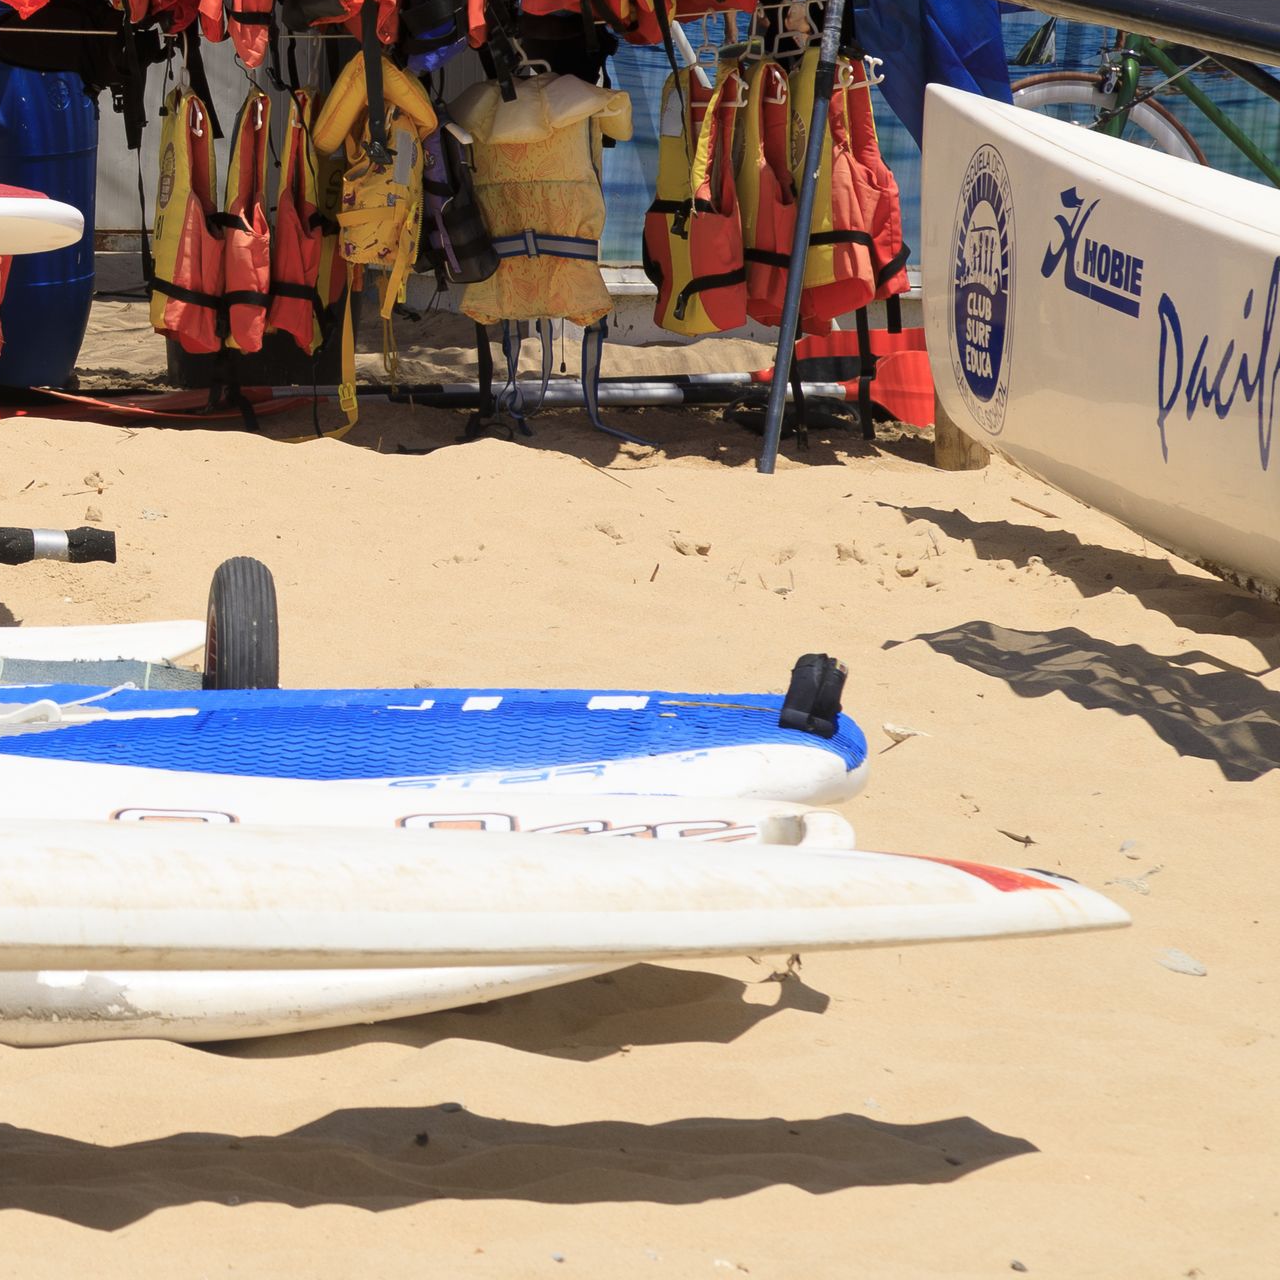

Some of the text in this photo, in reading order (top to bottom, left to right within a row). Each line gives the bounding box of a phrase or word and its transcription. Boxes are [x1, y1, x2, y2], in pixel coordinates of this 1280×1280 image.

[1083, 237, 1144, 297] HOBIE
[967, 292, 992, 321] CLUB
[966, 318, 992, 348] SURF
[966, 344, 993, 379] EDUCA
[1157, 255, 1280, 472] Pacif
